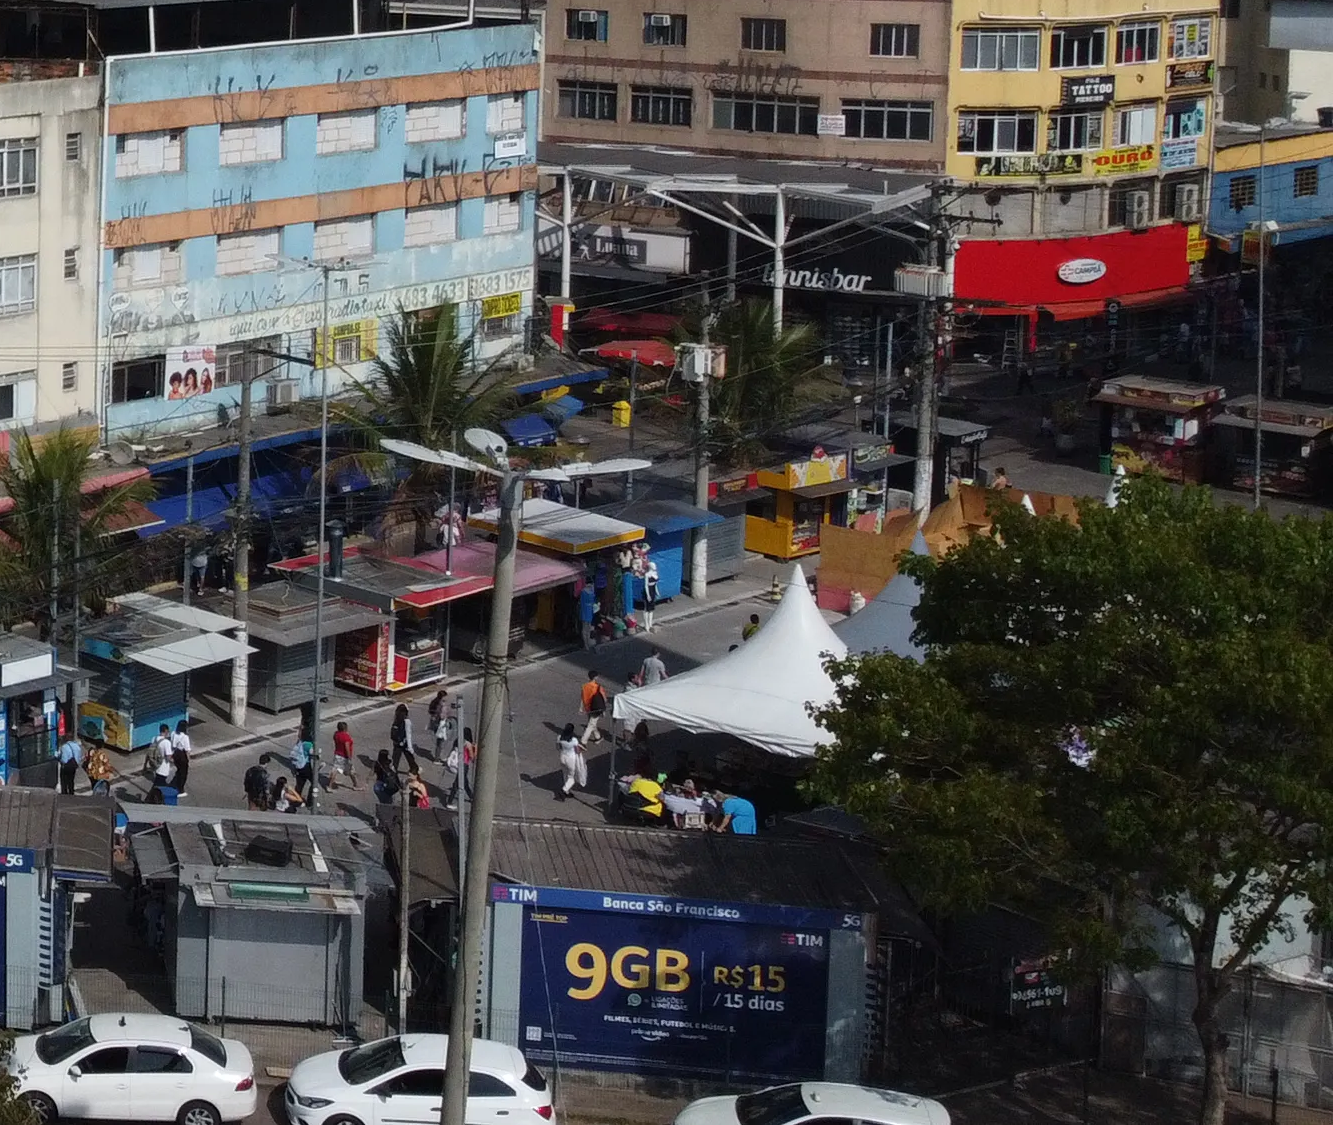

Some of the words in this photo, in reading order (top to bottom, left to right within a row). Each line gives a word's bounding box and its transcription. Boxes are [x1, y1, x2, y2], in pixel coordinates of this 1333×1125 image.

[1071, 83, 1113, 96] TATTOO
[1095, 150, 1154, 166] OURO
[595, 237, 638, 257] Luana
[762, 262, 872, 292] tnnisbar
[5, 853, 24, 868] 5G
[509, 887, 538, 902] TIM
[602, 897, 644, 912] Banca
[647, 898, 672, 914] São
[675, 902, 741, 920] Francisco
[841, 913, 861, 928] 5G
[795, 933, 824, 947] TIM
[565, 942, 691, 1000] 9GB
[713, 964, 786, 993] R$15
[748, 996, 785, 1012] dias
[660, 1019, 694, 1029] FUTEBOL
